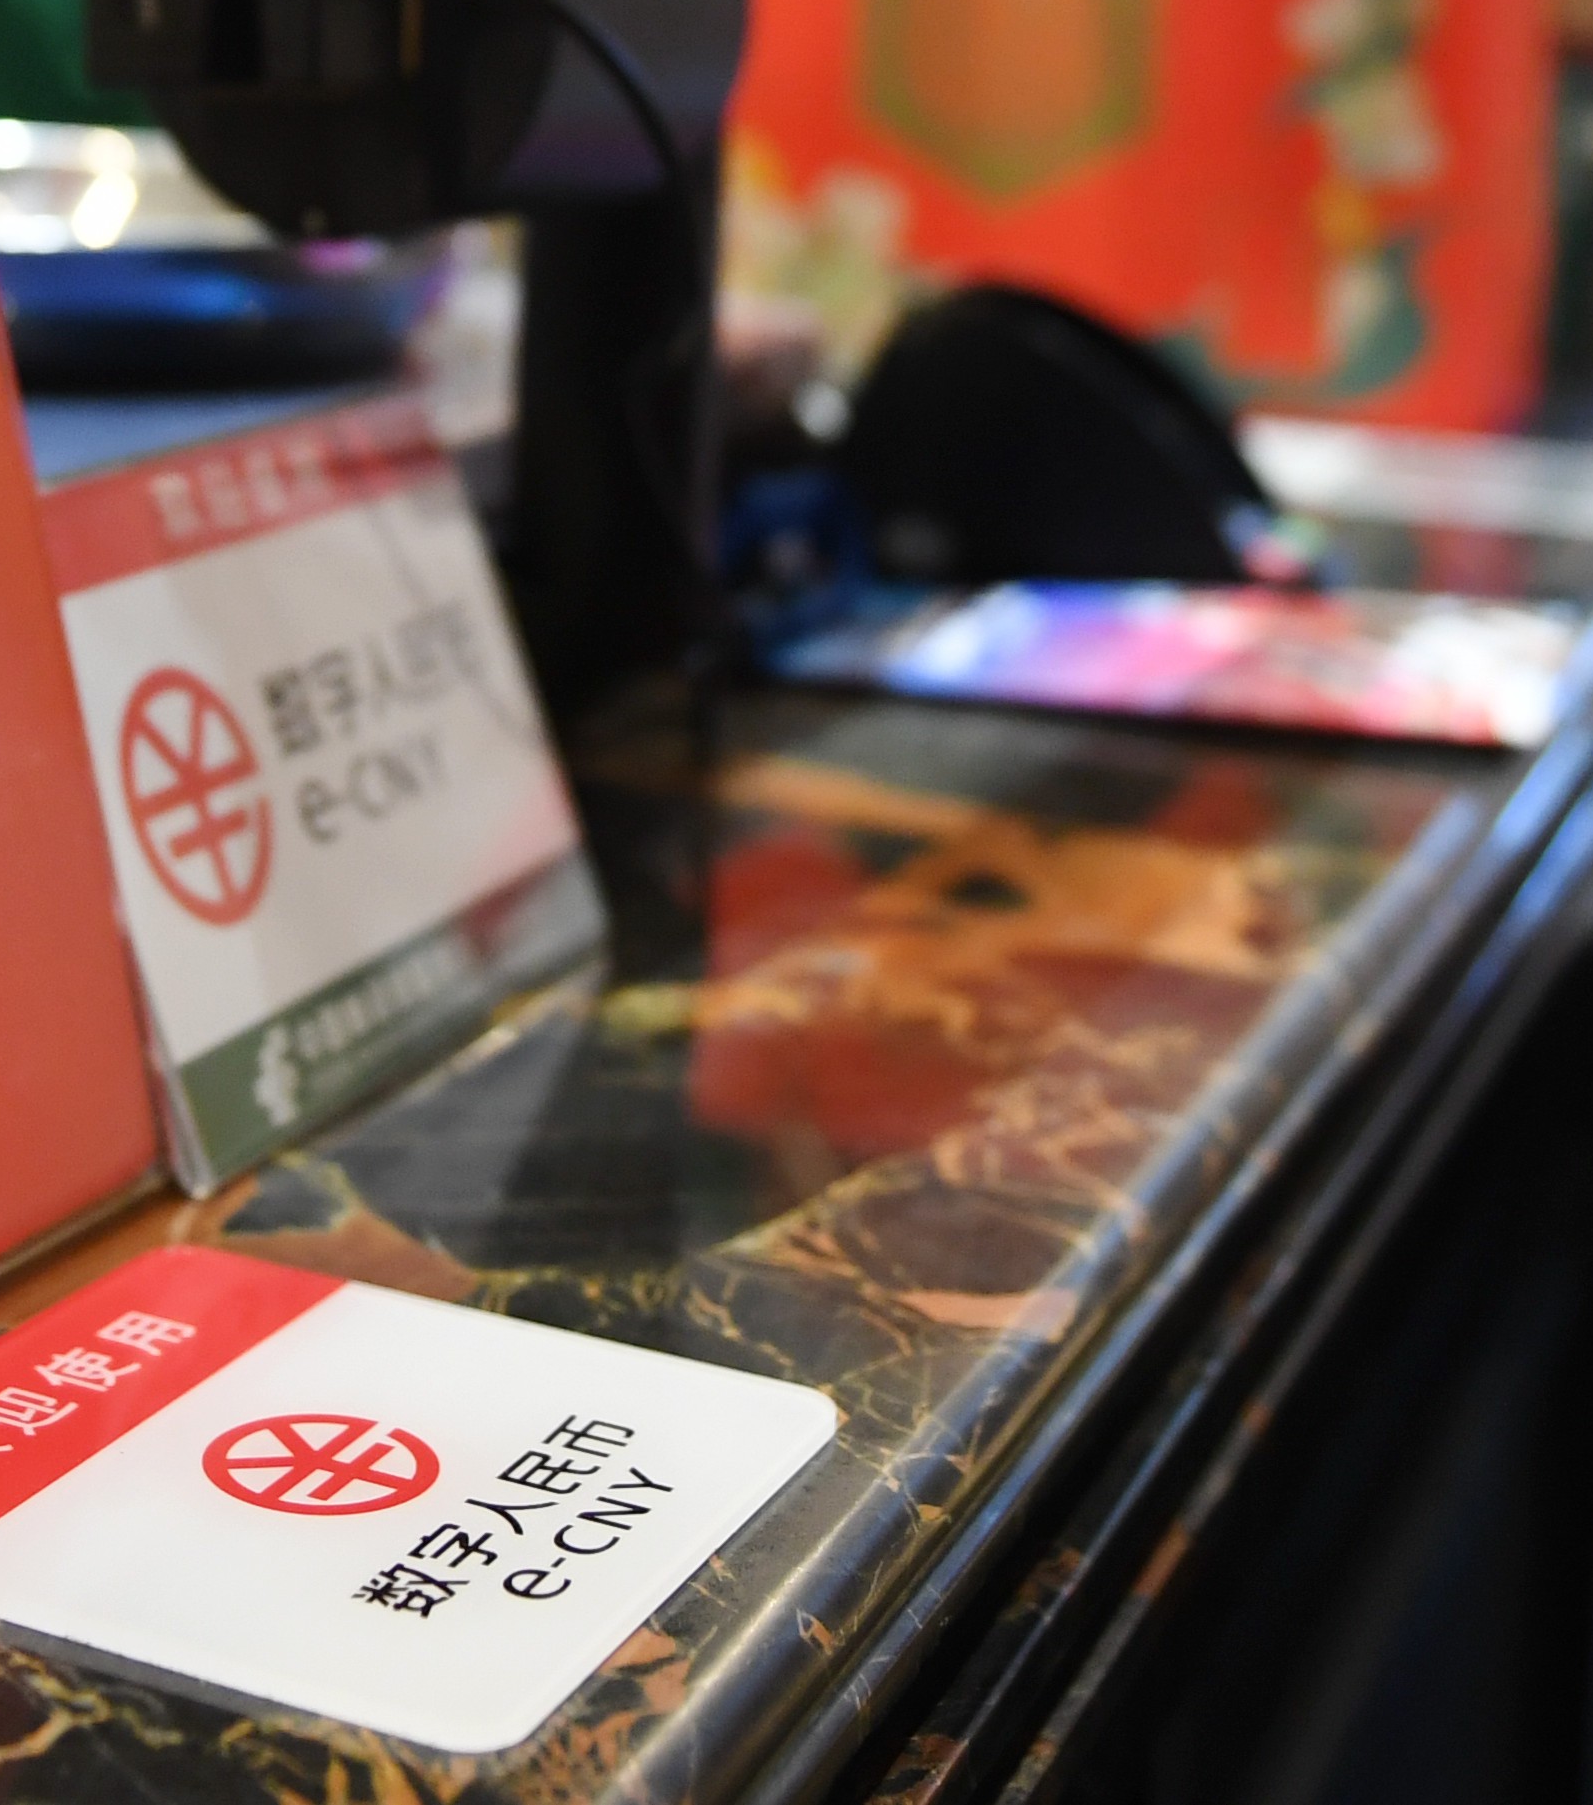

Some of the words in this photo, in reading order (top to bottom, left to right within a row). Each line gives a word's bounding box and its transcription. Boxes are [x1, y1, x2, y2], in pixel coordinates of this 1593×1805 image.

[350, 1414, 635, 1619] 数字人民币
[502, 1467, 674, 1600] e-CNY
